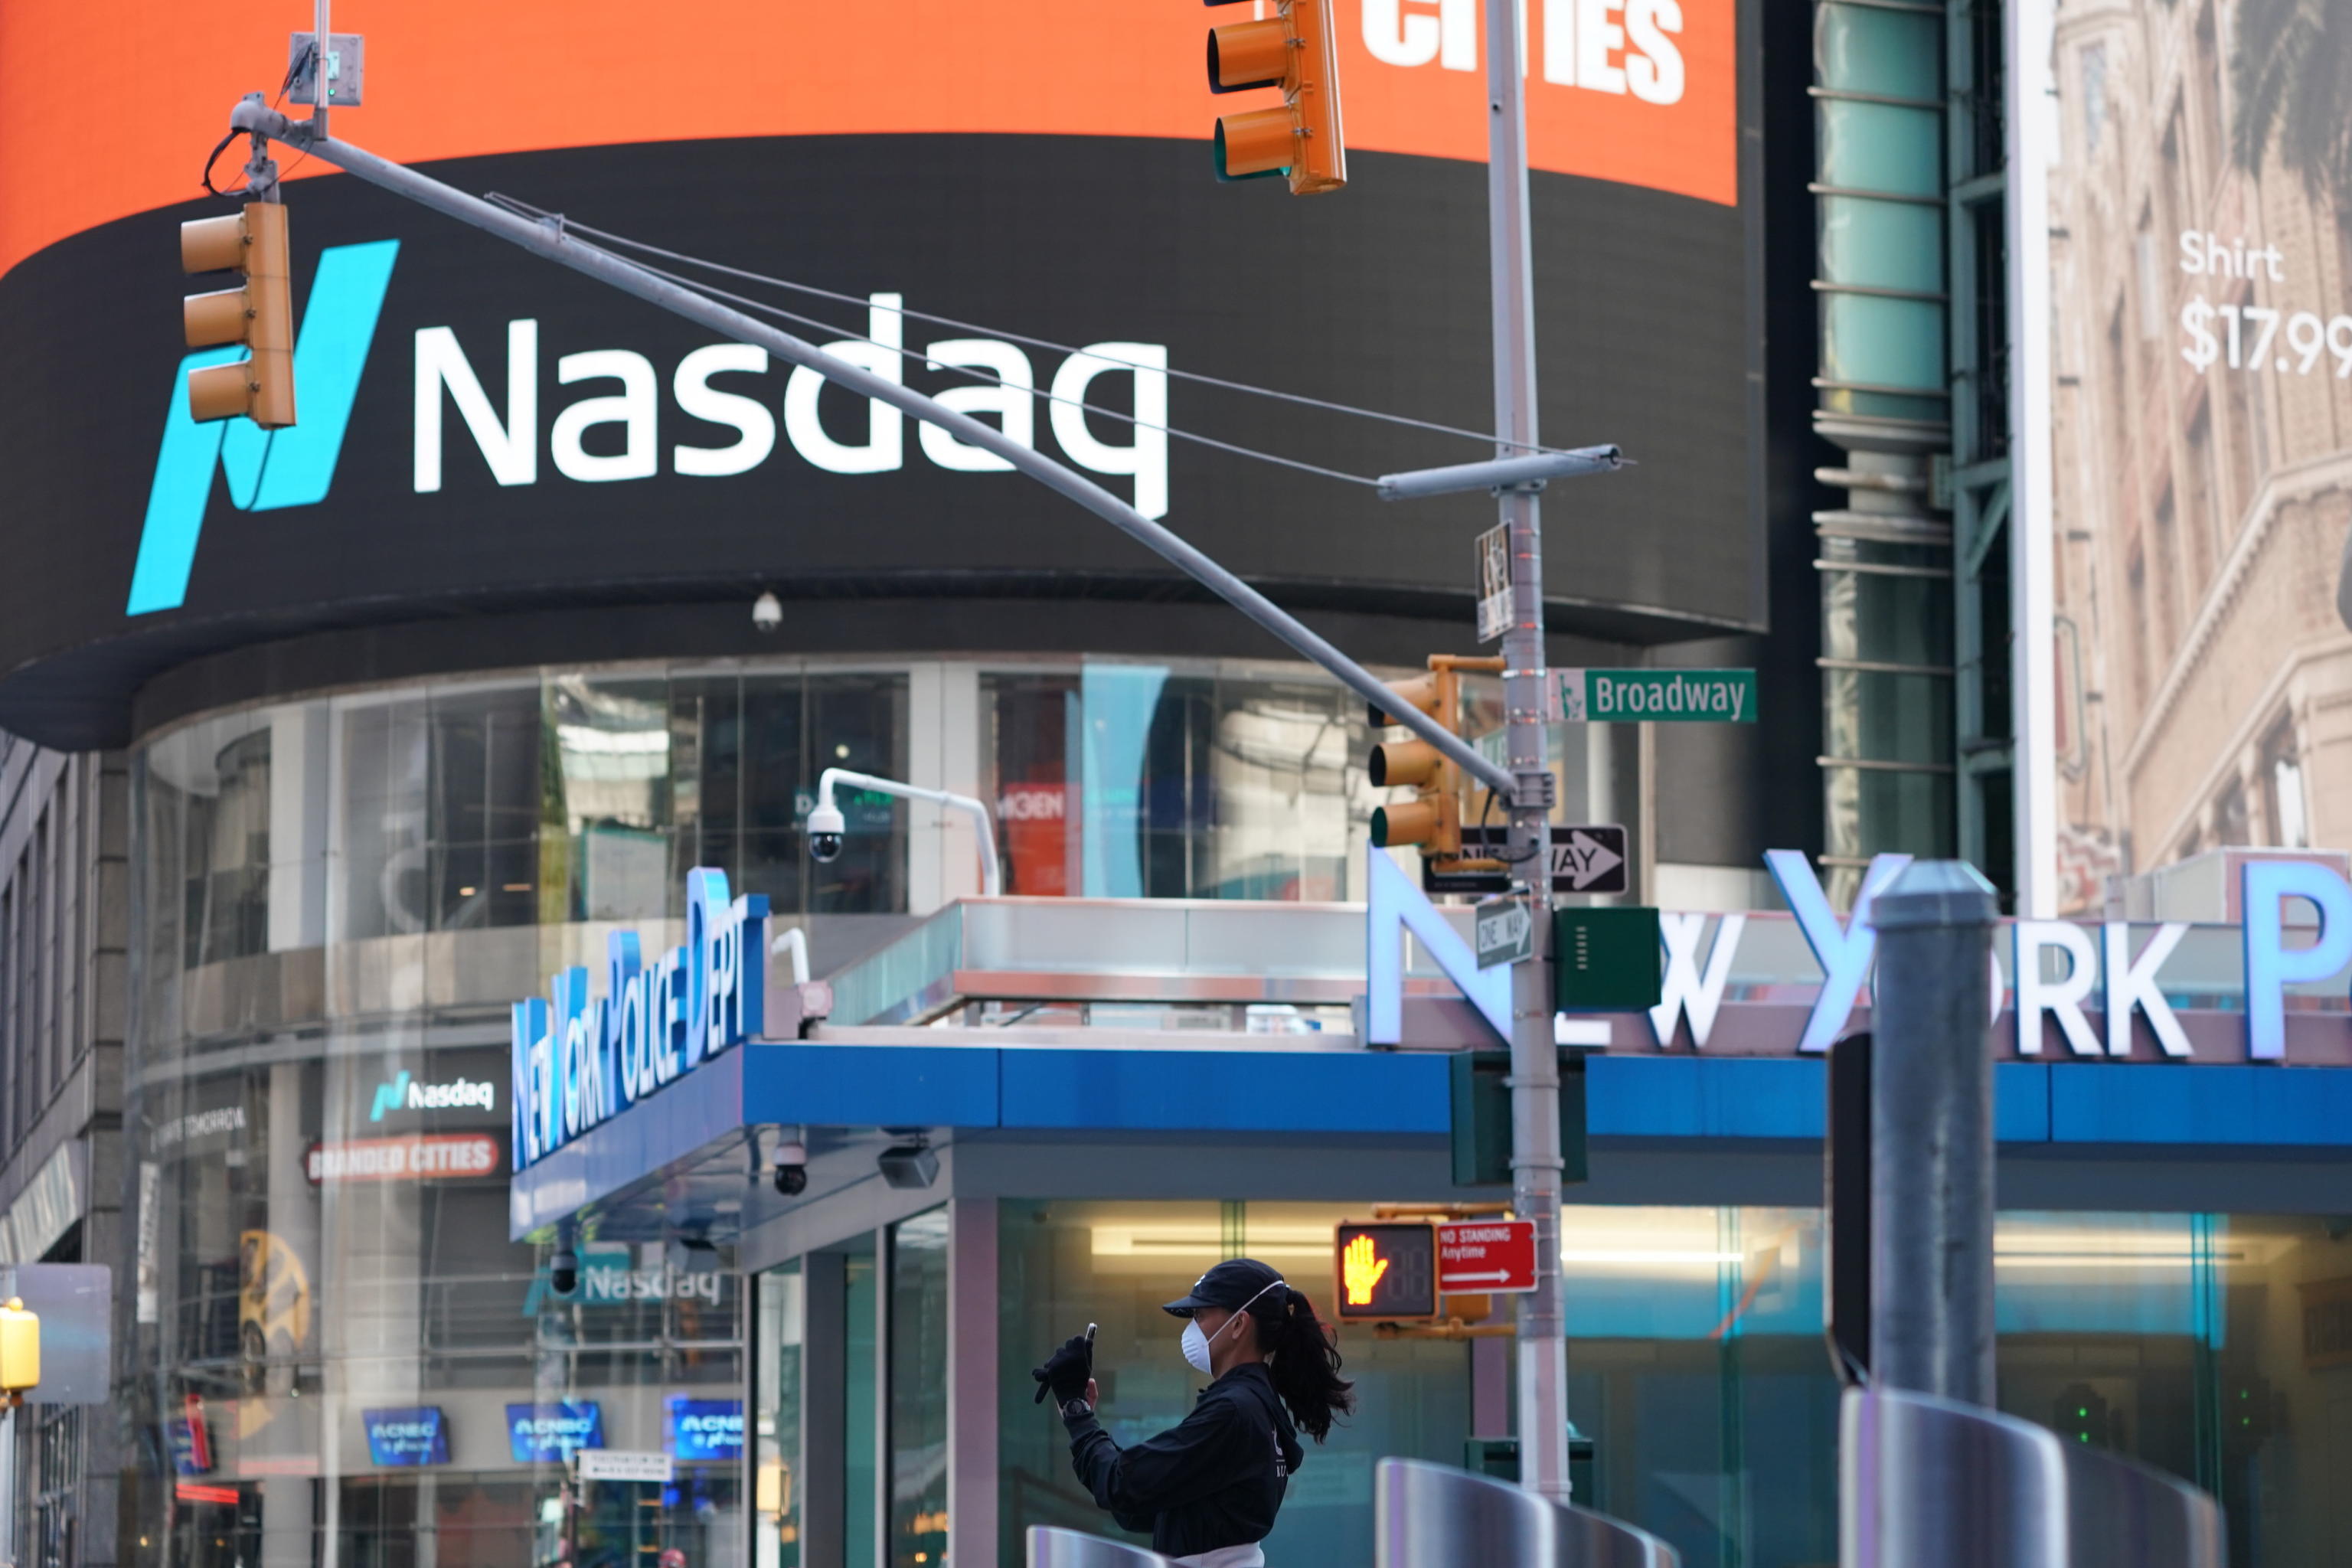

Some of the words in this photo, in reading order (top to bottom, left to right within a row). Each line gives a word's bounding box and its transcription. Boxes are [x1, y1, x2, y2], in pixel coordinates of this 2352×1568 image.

[1361, 0, 1685, 105] CIIES
[2179, 229, 2285, 283] Shirt
[2181, 295, 2352, 379] $17.99
[413, 292, 1169, 521] Nasdaq
[1596, 675, 1745, 722] Broadway
[1551, 848, 1597, 873] AY
[1369, 839, 1746, 1049] NW
[1765, 848, 2195, 1057] YRK
[607, 929, 687, 1116] POLICE
[686, 866, 758, 1068] DEPT
[408, 1077, 495, 1112] Nasdaq
[309, 1144, 406, 1181] BRANDED
[409, 1139, 492, 1172] CITIES
[1440, 1229, 1456, 1244] NO
[1459, 1227, 1511, 1243] STANDING
[1442, 1246, 1486, 1263] Anytime
[585, 1263, 722, 1306] Nasdaq
